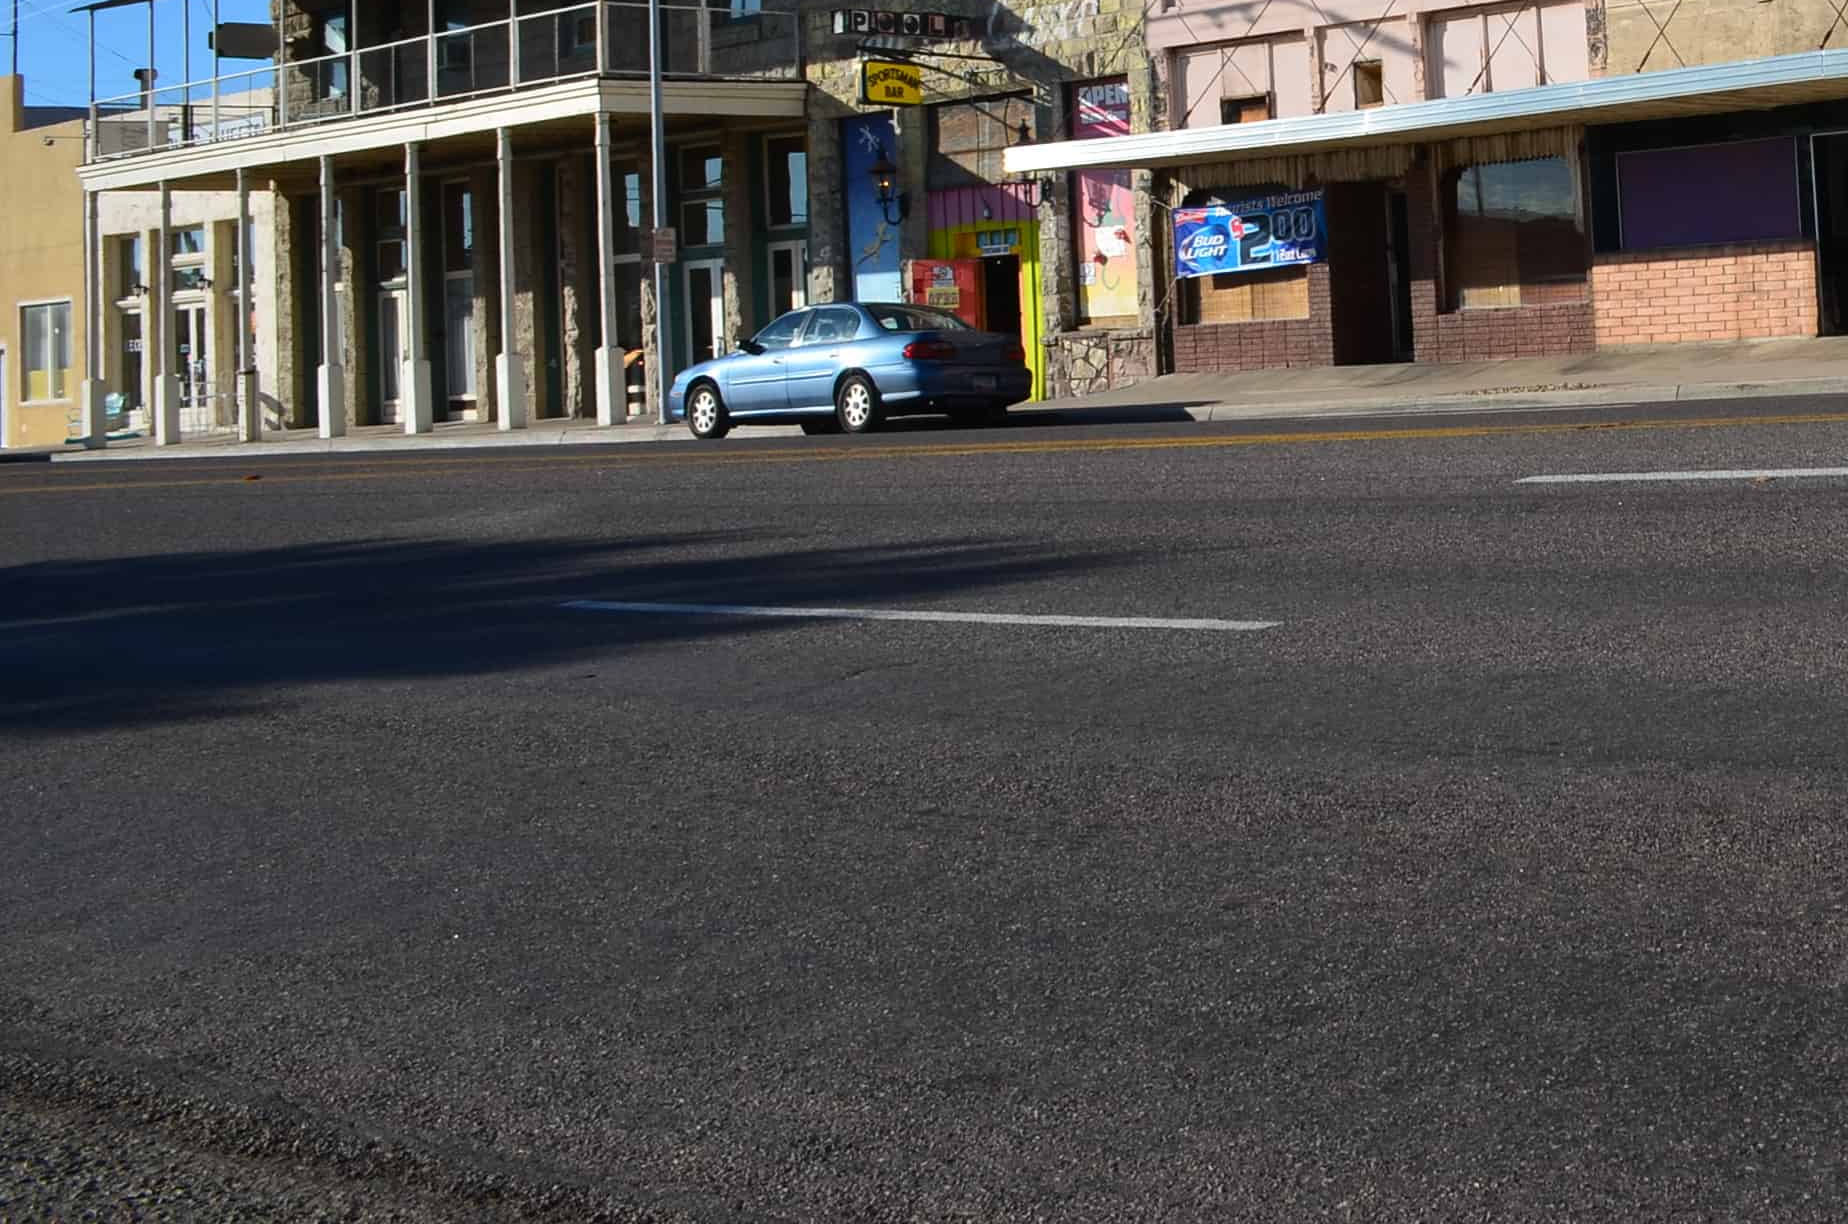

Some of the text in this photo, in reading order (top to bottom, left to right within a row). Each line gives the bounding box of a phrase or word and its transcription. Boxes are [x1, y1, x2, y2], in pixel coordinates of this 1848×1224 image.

[852, 11, 945, 35] POOL
[870, 67, 920, 90] SPORTSMAN
[884, 86, 904, 97] BAR
[1266, 189, 1323, 209] Welcome
[1193, 234, 1225, 247] BUD
[1183, 245, 1228, 260] LIGHT
